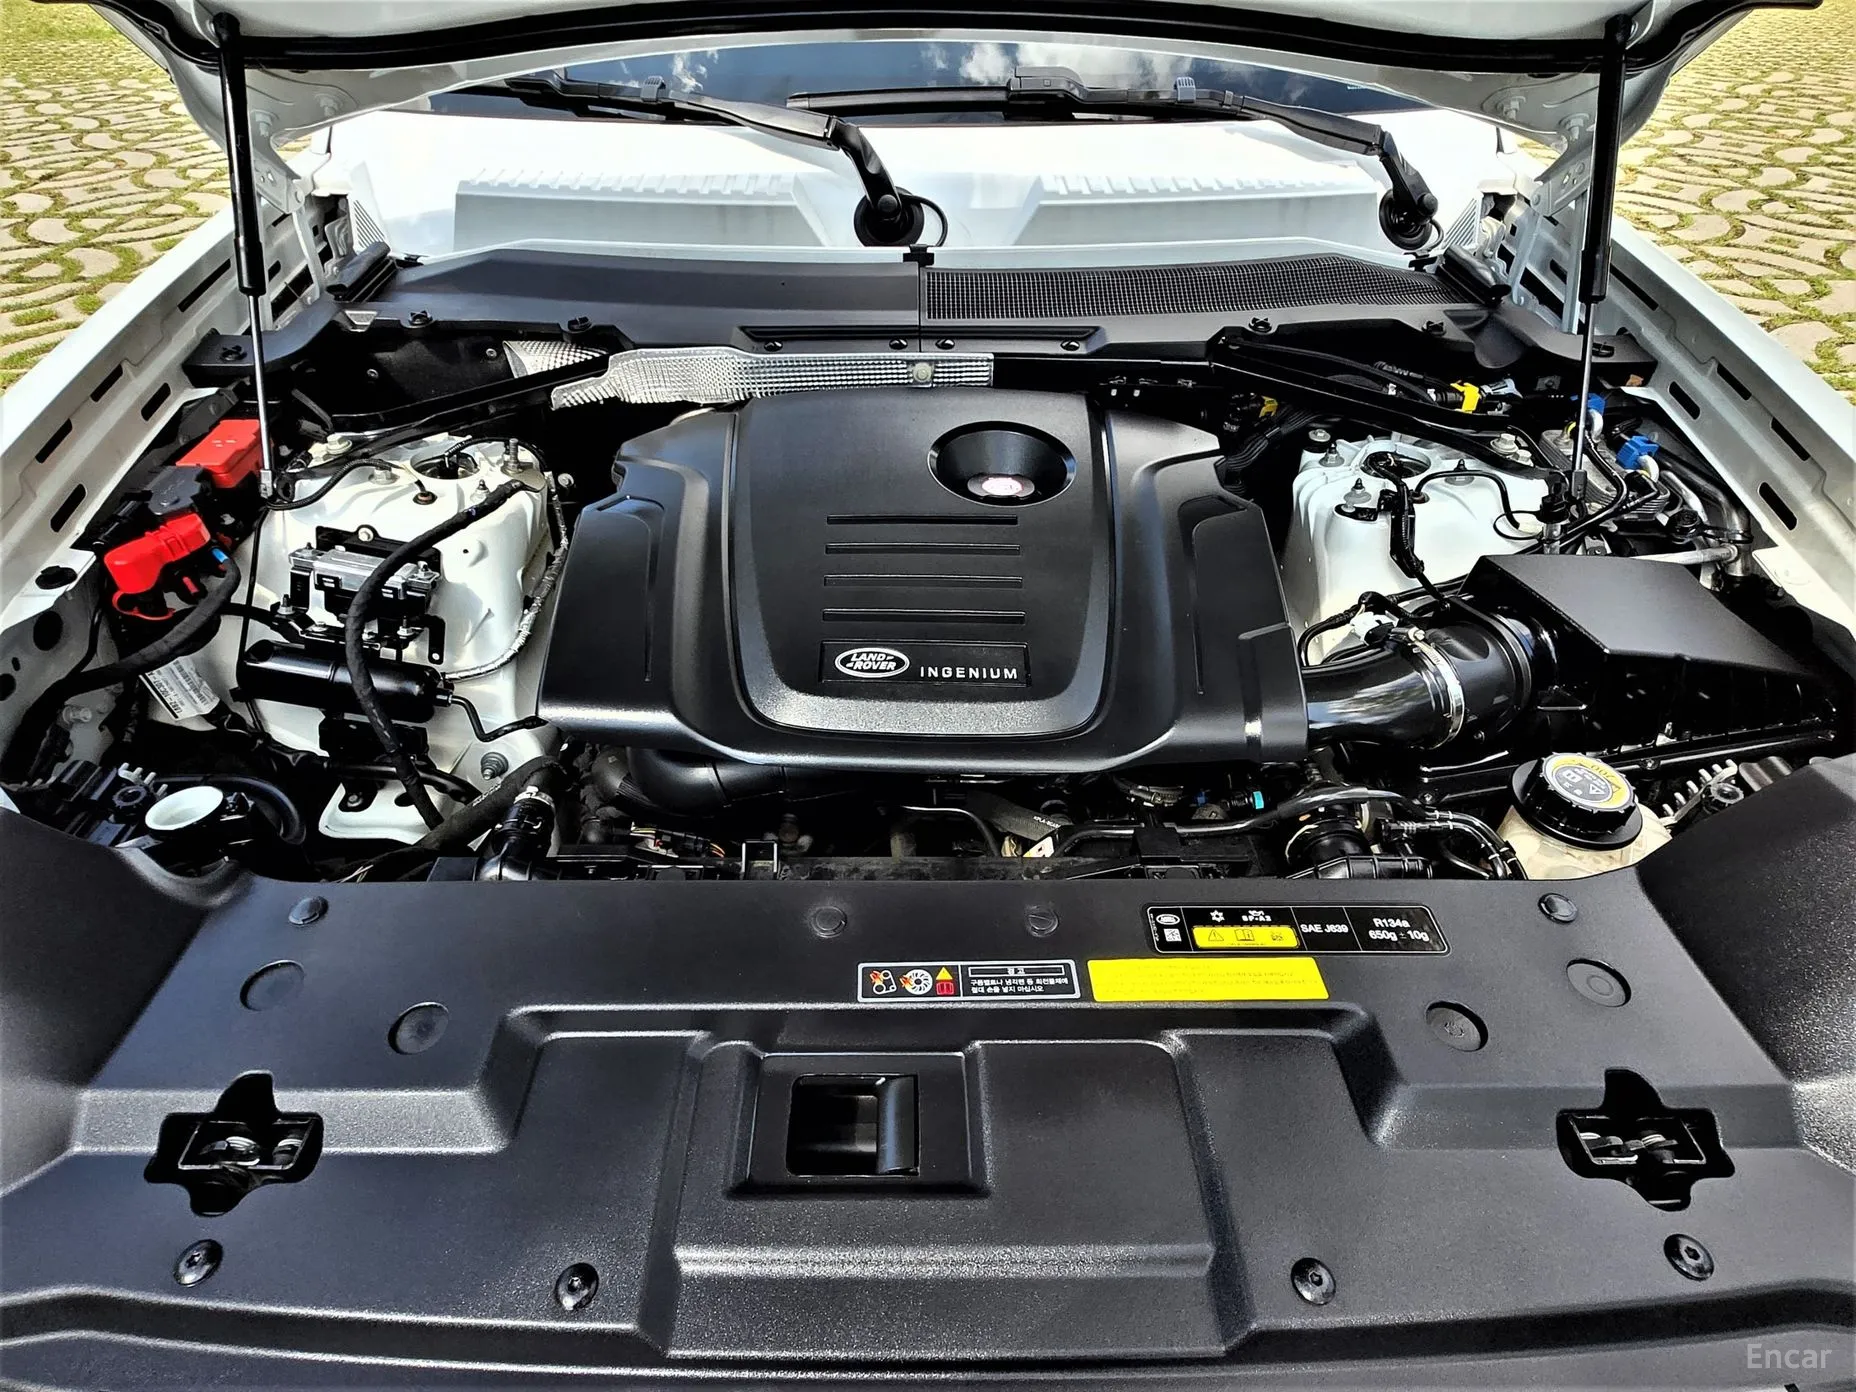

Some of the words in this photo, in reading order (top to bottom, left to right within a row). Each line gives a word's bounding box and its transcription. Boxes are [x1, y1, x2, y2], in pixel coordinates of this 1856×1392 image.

[850, 652, 888, 662] LAND
[853, 661, 897, 671] ROVER
[920, 666, 1018, 680] INGENIUM
[1372, 917, 1411, 928] R134a
[1300, 924, 1323, 933] SAE
[1324, 924, 1349, 933] J639
[1368, 930, 1399, 942] 650g
[1406, 930, 1430, 942] 10g
